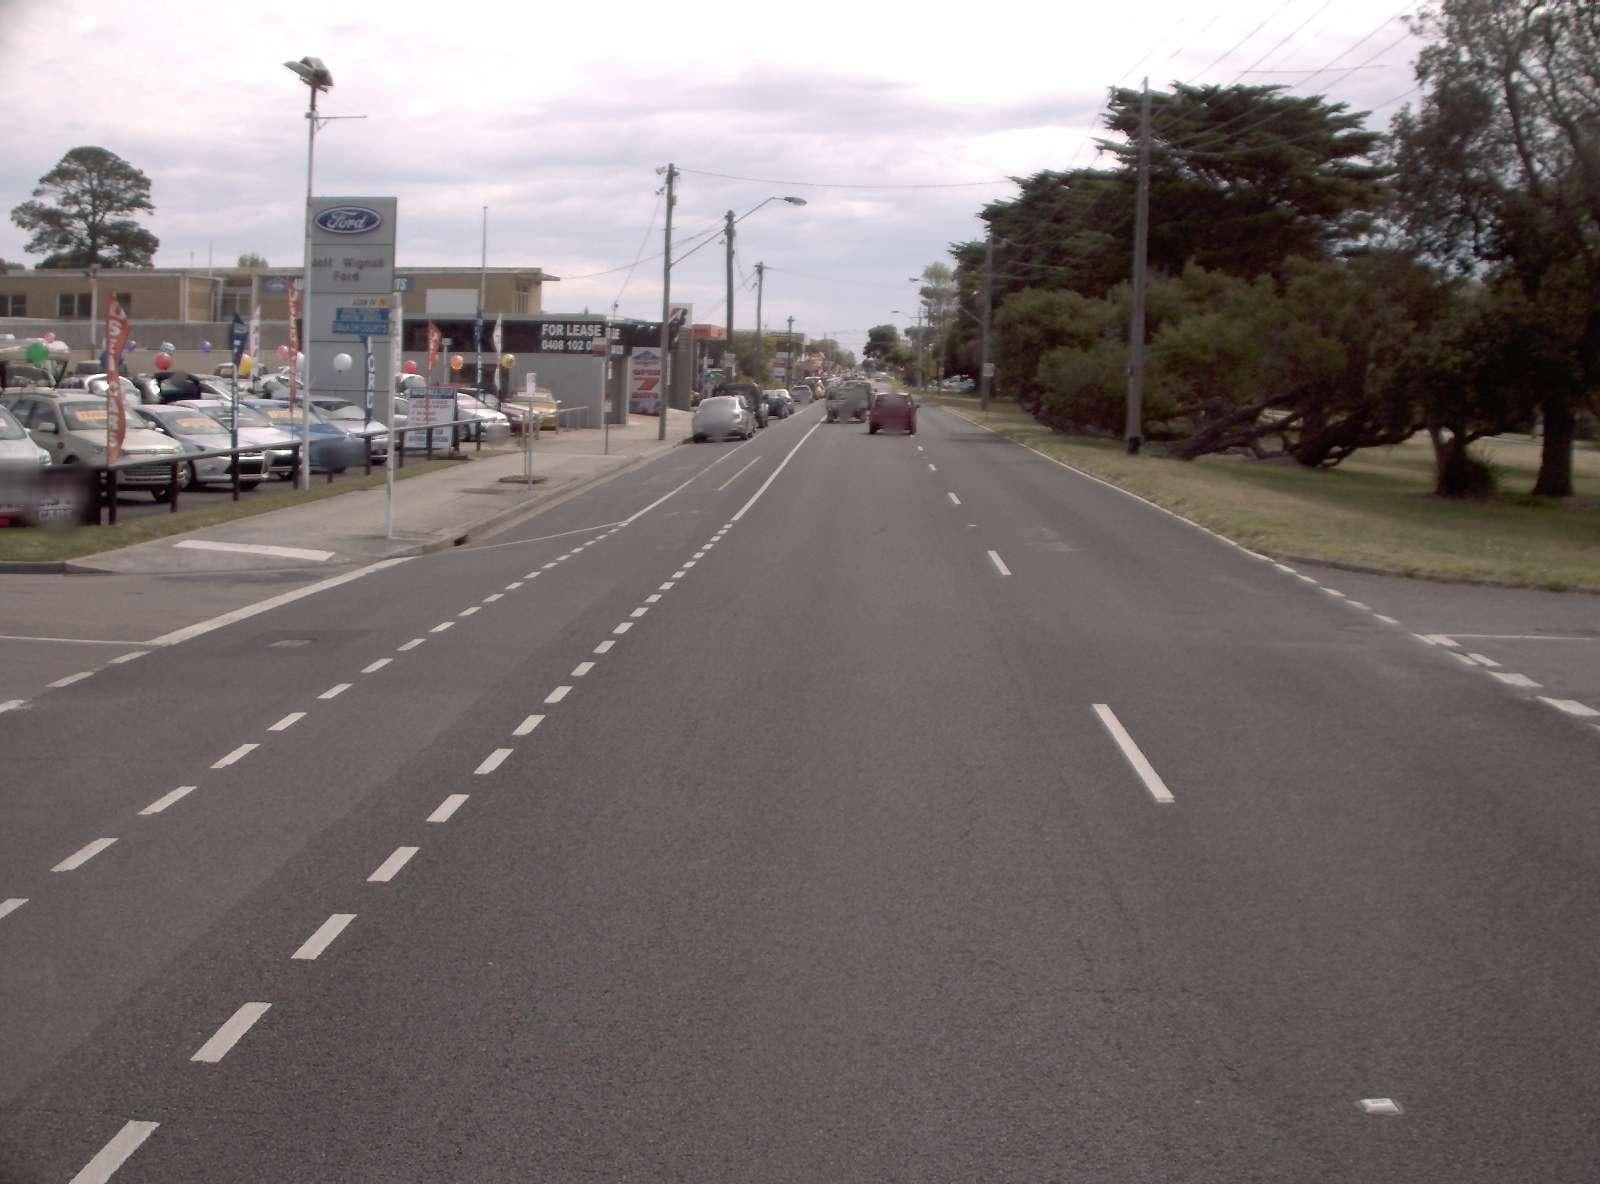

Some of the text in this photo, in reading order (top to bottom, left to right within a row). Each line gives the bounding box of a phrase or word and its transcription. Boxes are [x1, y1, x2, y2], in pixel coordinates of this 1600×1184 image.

[326, 210, 368, 229] Ford
[541, 324, 602, 337] FOR LEASE
[541, 340, 564, 350] 0408
[567, 340, 584, 350] 102
